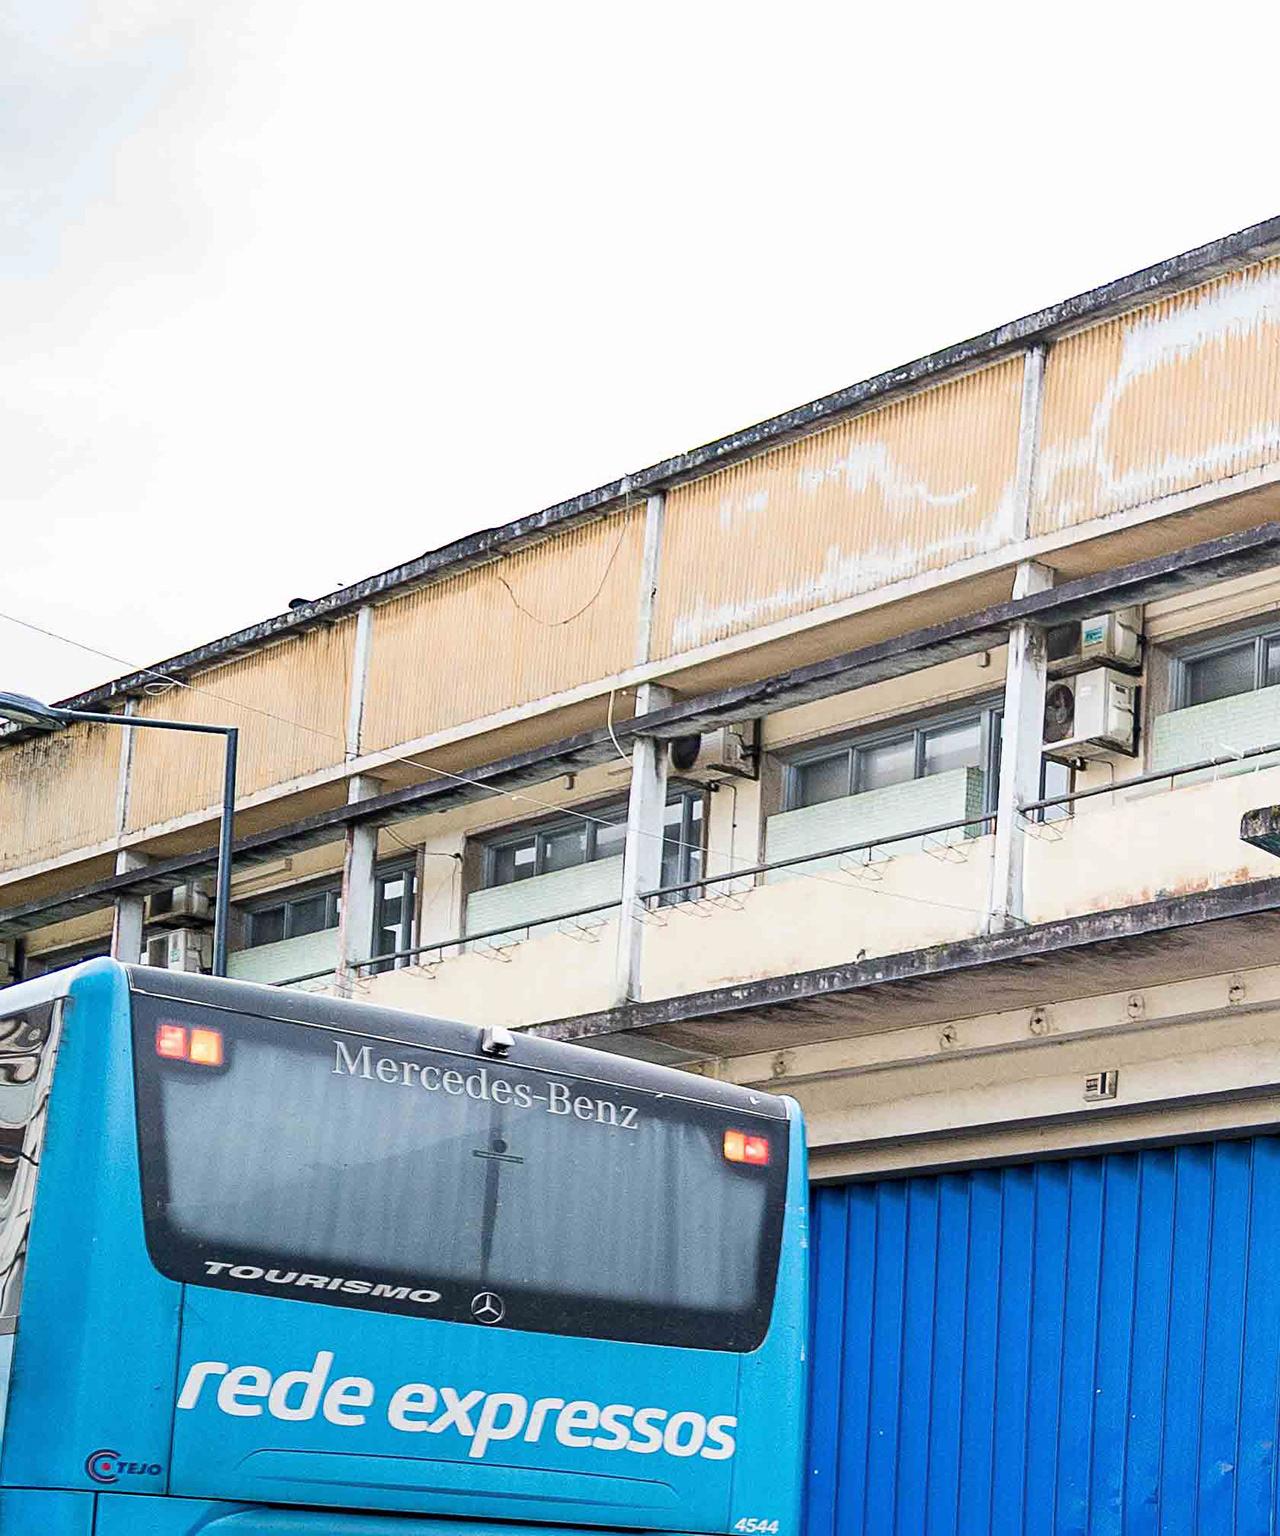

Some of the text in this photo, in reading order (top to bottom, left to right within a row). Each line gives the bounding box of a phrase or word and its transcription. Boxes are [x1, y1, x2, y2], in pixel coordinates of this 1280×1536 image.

[332, 1040, 639, 1130] Mercedes-Benz
[204, 1261, 442, 1304] TOURISMO
[177, 1351, 738, 1461] rede expressos
[734, 1517, 780, 1534] 4544
